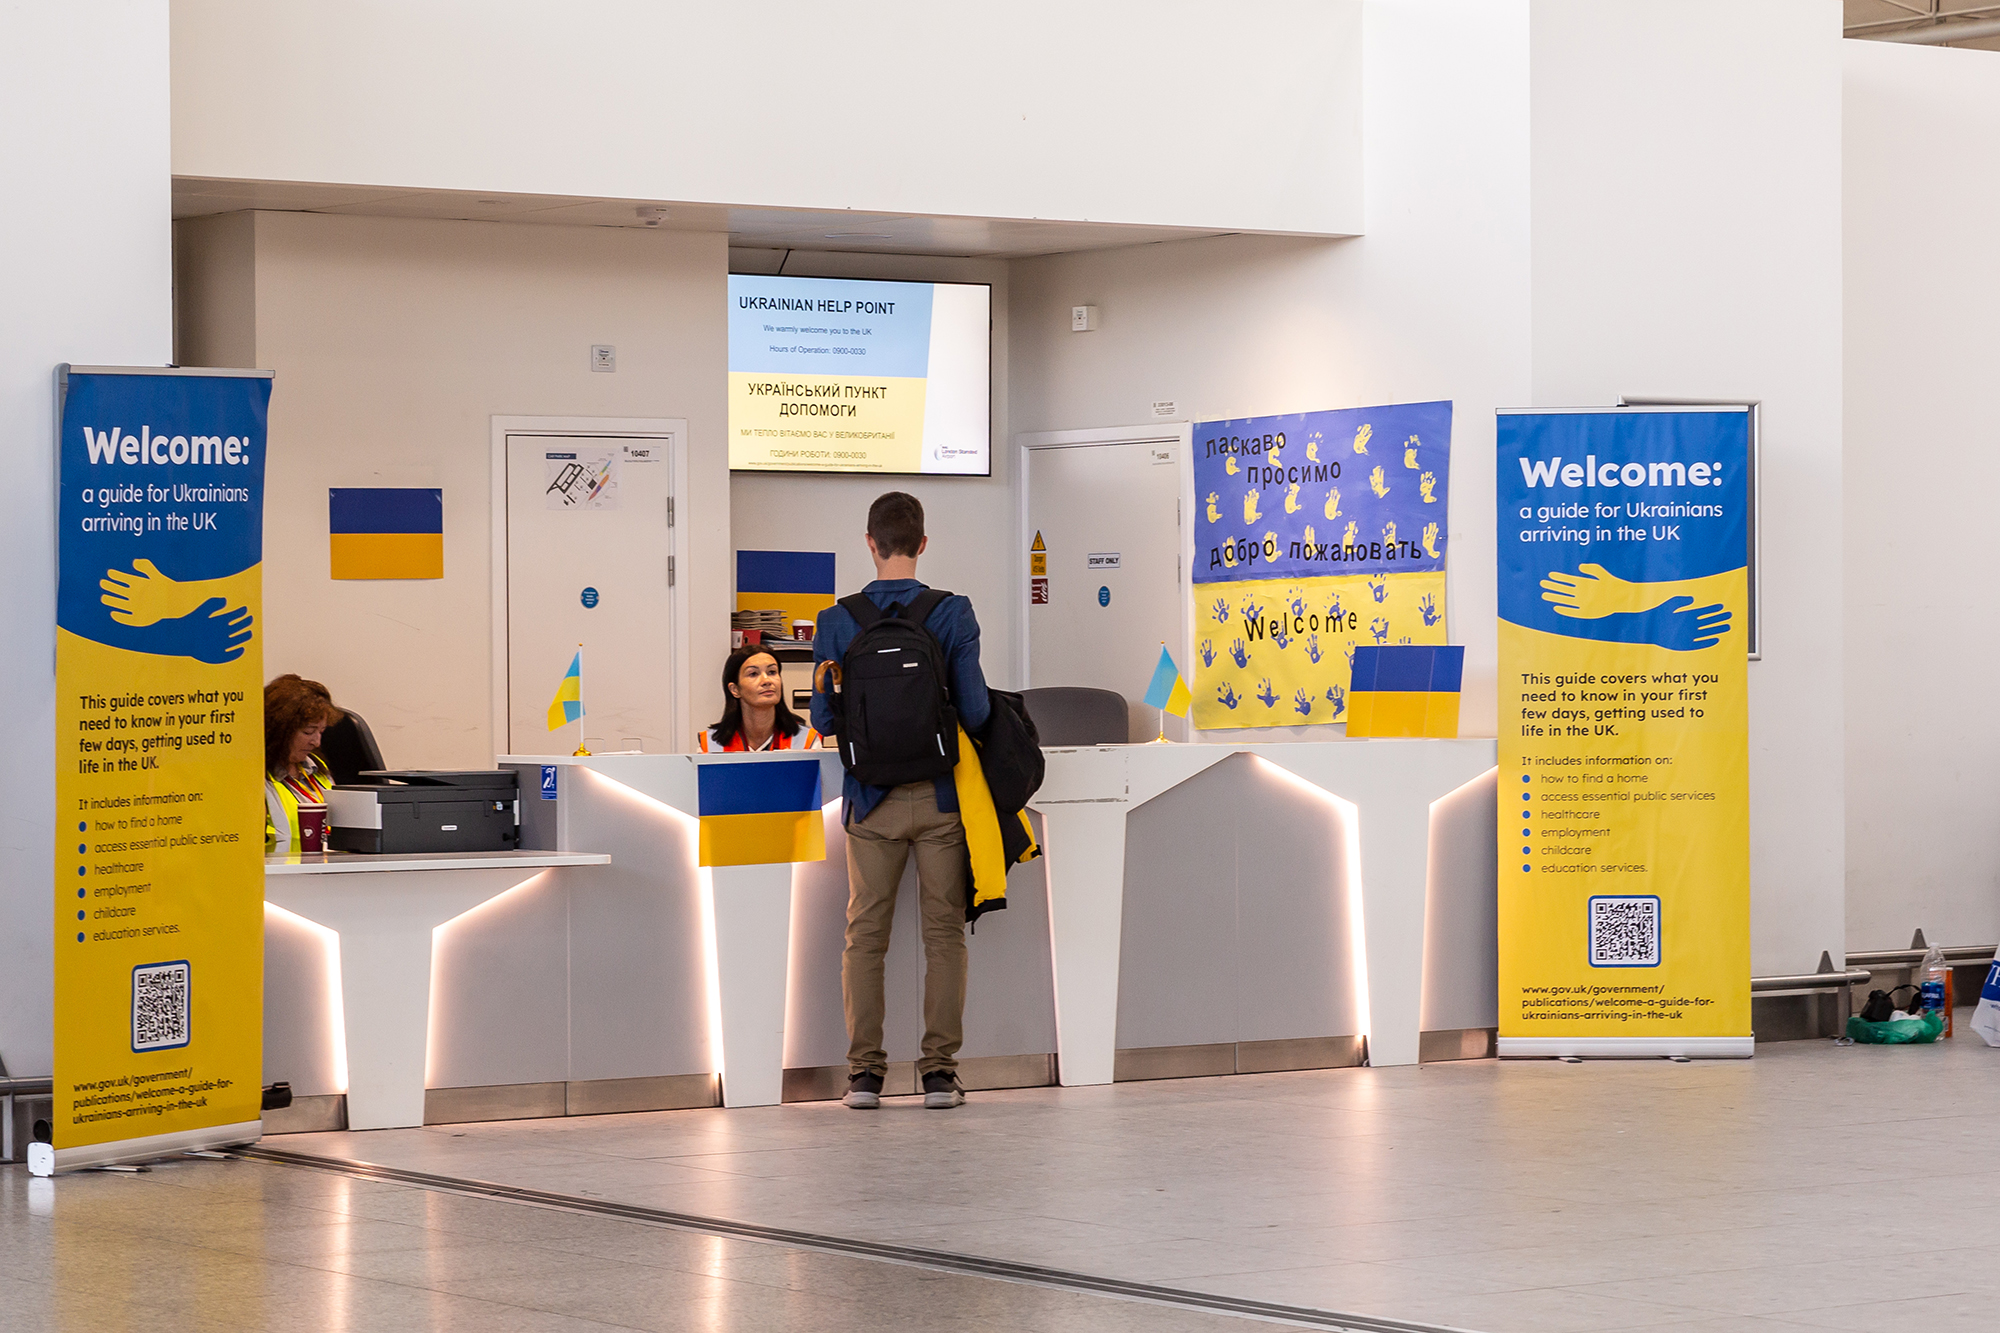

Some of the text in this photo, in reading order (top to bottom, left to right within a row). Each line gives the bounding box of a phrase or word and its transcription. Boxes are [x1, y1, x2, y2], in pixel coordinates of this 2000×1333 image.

[740, 296, 895, 315] UKRAINIAN HELP POINT
[764, 324, 774, 332] We
[776, 326, 798, 336] warmly
[800, 326, 828, 335] welcome
[830, 328, 841, 336] you
[850, 328, 860, 336] the
[862, 328, 872, 336] UK
[770, 345, 866, 356] Hours of Operation: 0900-0030
[748, 382, 887, 400] УКРАЇНСЬКИЙ ПУНКТ
[780, 404, 856, 418] ДОПОМОГИ
[754, 430, 778, 438] ТЕПЛО
[780, 430, 812, 438] ВІТАЄМО
[814, 430, 827, 438] ВАС
[829, 431, 834, 439] У
[83, 425, 250, 465] Welcome:
[1205, 432, 1287, 458] ласкаво
[770, 450, 866, 460] ГОДИНИ РОБОТИ: 0900-0030
[1247, 461, 1342, 490] просимо
[1518, 454, 1723, 489] Welcome:
[82, 483, 249, 508] a guide for Ukrainians
[1519, 501, 1723, 523] a guide for Ukrainians
[81, 512, 217, 536] arriving in the UK
[1519, 525, 1680, 546] arriving in the UK
[1210, 538, 1423, 570] добро пожаловать
[1244, 611, 1358, 642] Welcome
[1521, 671, 1719, 689] This guide covers what you
[80, 689, 244, 712] This guide covers what you
[1521, 688, 1708, 705] need to know in your first
[79, 709, 235, 731] need to know in your first
[1521, 706, 1704, 722] few days, getting used to
[1521, 723, 1619, 737] life in the UK.
[79, 732, 232, 754] few days, getting used to
[79, 755, 160, 774] life in the UK.
[1521, 755, 1673, 766] It includes information on:
[1541, 773, 1648, 784] how to find a home
[79, 792, 203, 810] It includes information on:
[1540, 791, 1716, 803] access essential public services
[95, 815, 182, 831] how to find a home
[1541, 809, 1600, 819] healthcare
[1541, 827, 1611, 840] employment
[94, 832, 239, 854] access essential public services
[1541, 845, 1592, 855] childcare
[94, 862, 144, 875] healthcare
[1541, 863, 1648, 874] education services.
[93, 883, 151, 899] employment
[93, 906, 137, 920] childcare
[93, 923, 181, 942] education services.
[1521, 983, 1665, 996] www.gov.uk/government/
[1521, 997, 1715, 1009] publications/welcome-a-guide-for-
[1521, 1009, 1683, 1022] ukrainians-arriving-in-the-uk
[73, 1067, 193, 1093] www.gov.uk/government/
[73, 1079, 233, 1111] publications/welcome-a-guide-for-
[72, 1097, 208, 1125] ukrainians-arriving-in-the-uk
